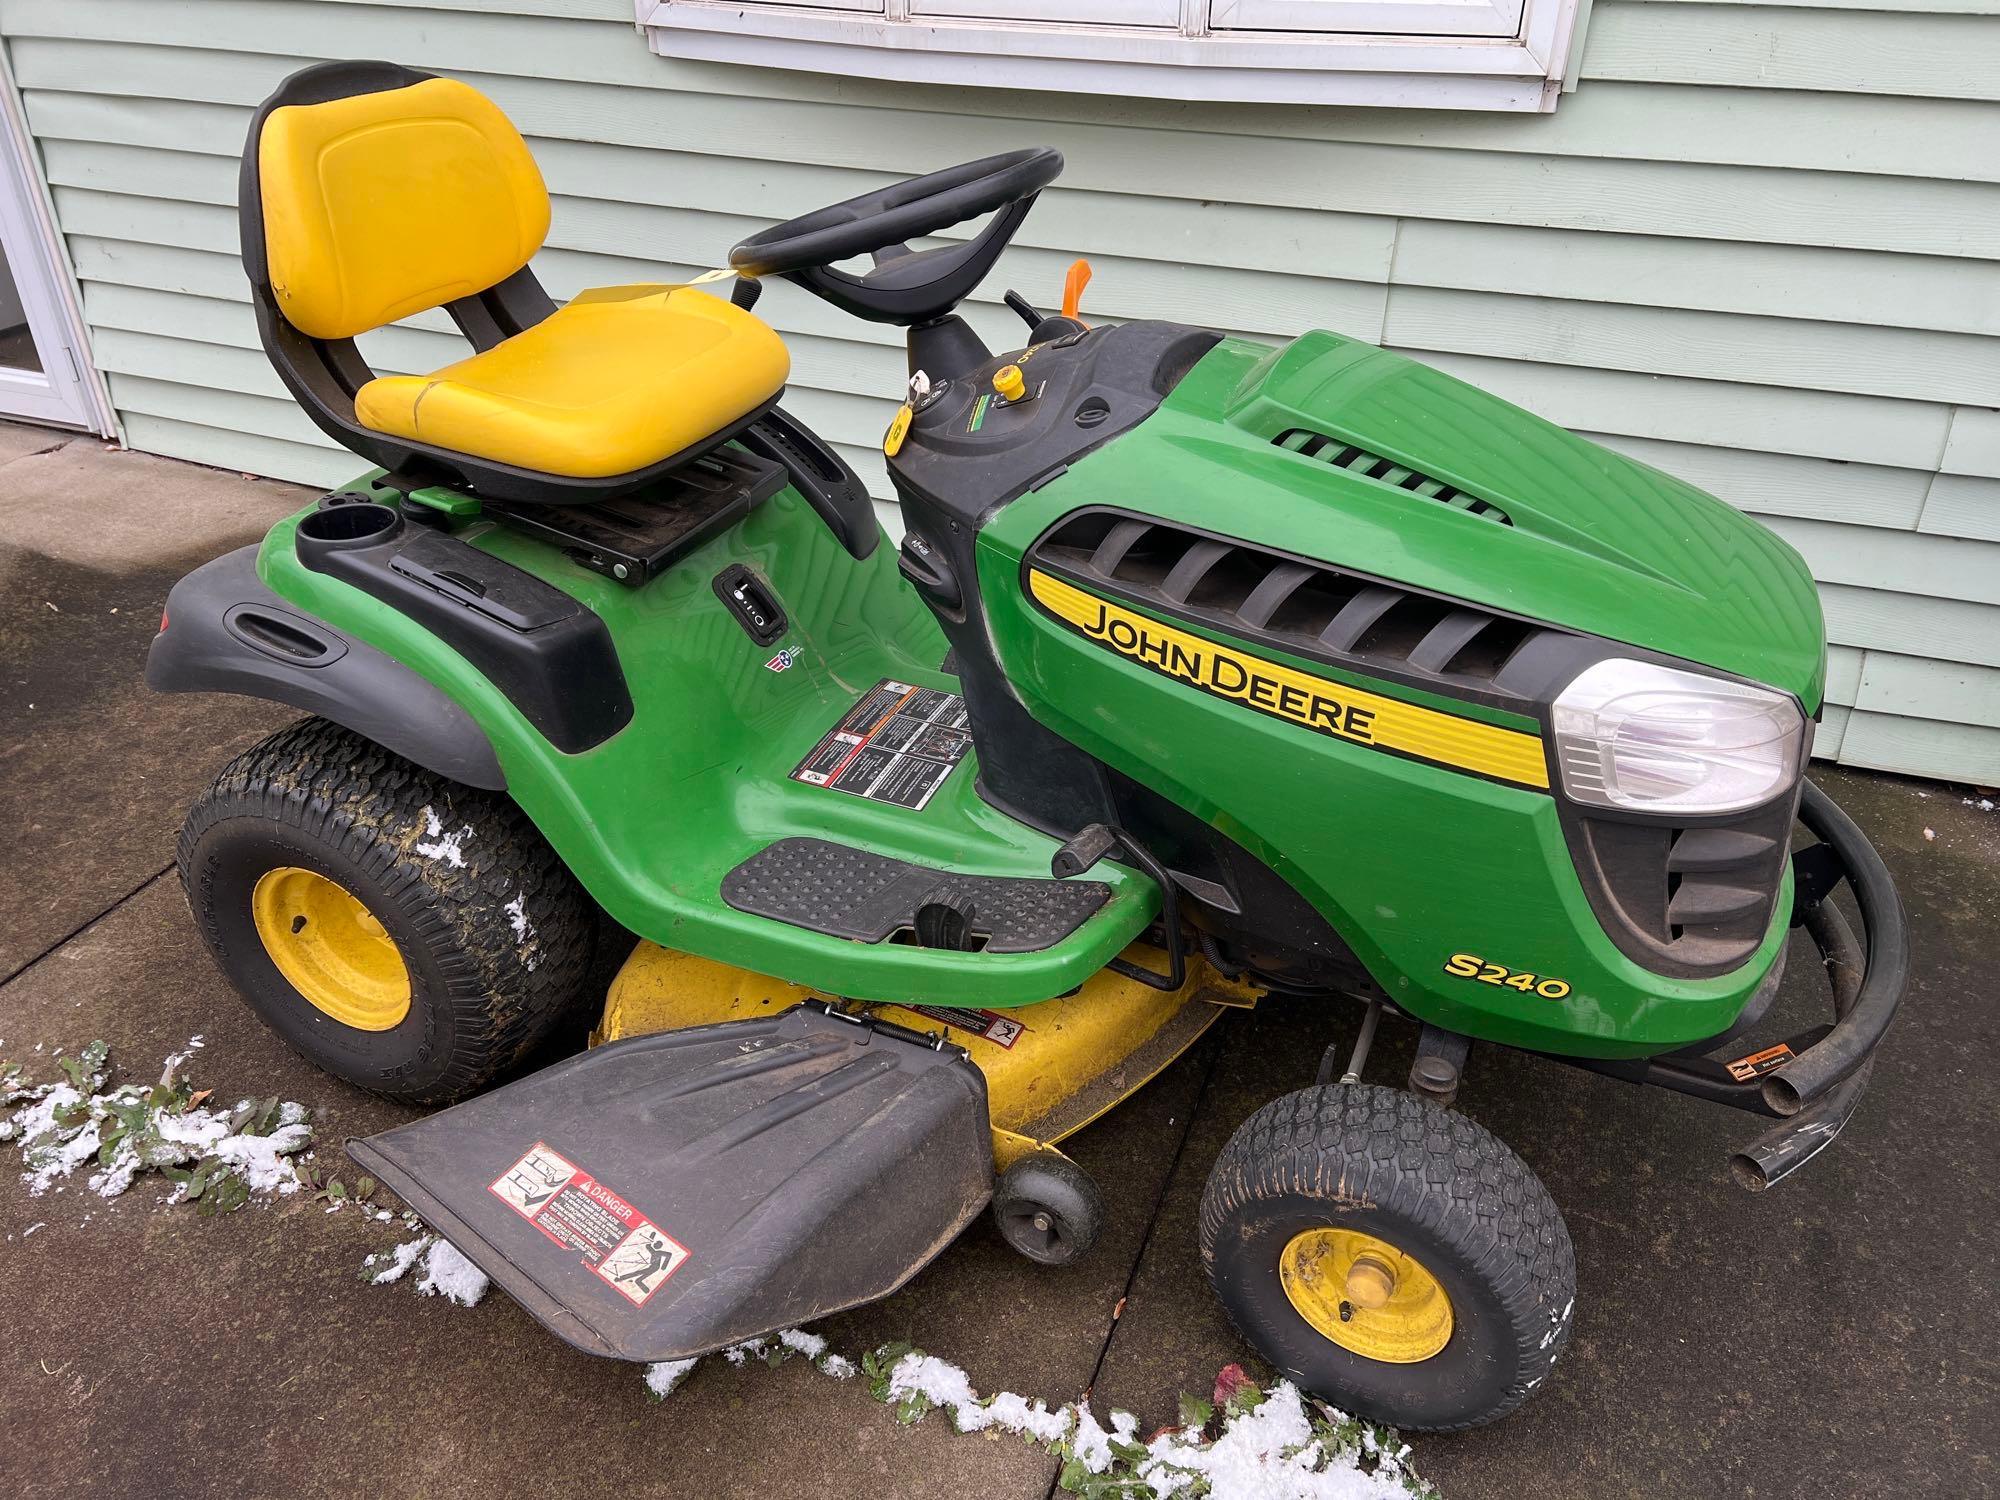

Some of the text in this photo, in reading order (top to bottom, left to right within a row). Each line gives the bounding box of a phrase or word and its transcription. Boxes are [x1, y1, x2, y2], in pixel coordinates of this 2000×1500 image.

[1083, 604, 1377, 741] JOHN DEERE
[1443, 953, 1571, 999] S240
[575, 1191, 620, 1225] ROTATING BLADE
[589, 1185, 634, 1220] DANGER
